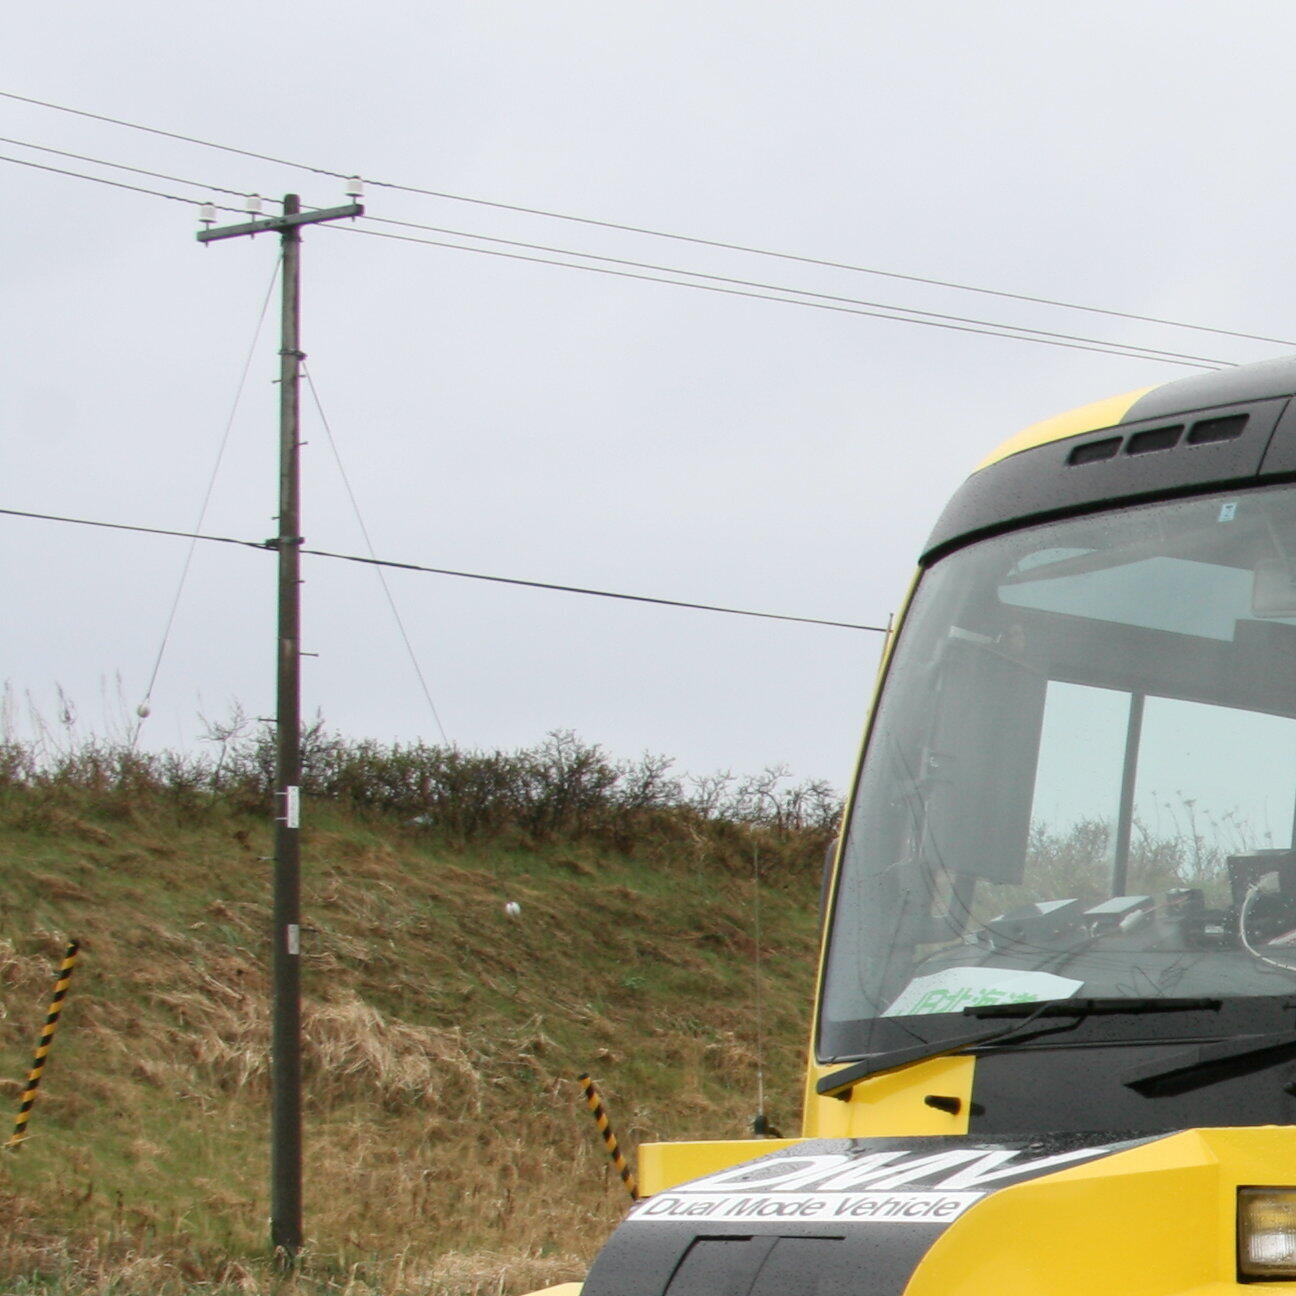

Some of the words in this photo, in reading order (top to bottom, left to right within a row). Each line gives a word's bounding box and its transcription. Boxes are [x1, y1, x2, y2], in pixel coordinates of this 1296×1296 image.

[674, 1148, 1112, 1192] DMV
[643, 1196, 727, 1218] Dual
[722, 1196, 827, 1218] Mode
[832, 1196, 962, 1219] Vehicle
